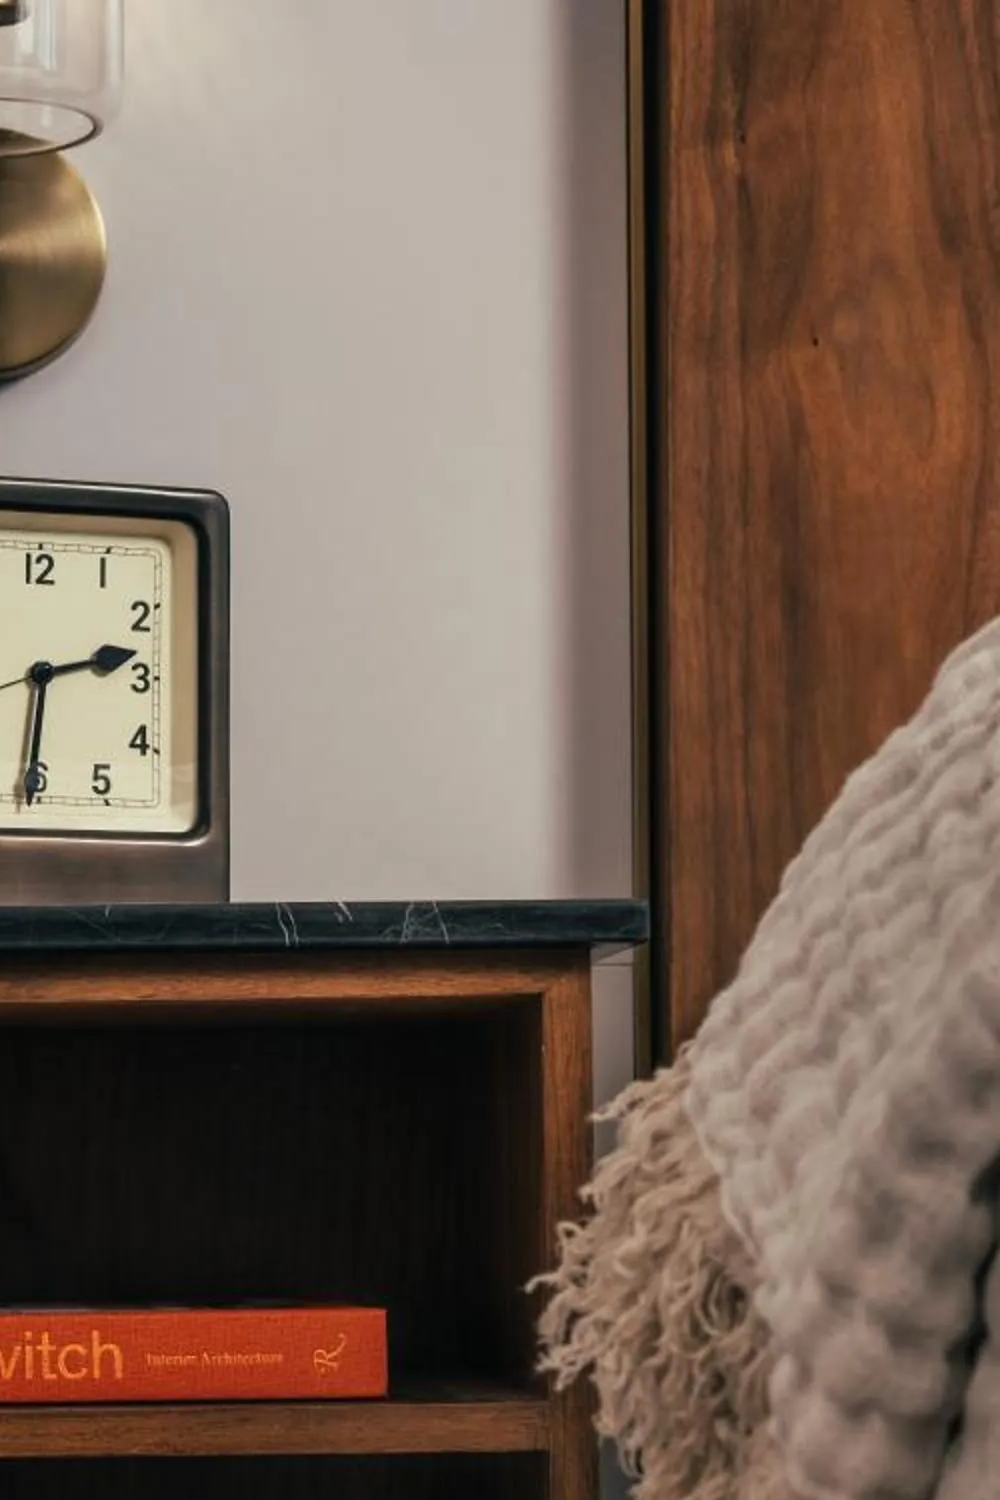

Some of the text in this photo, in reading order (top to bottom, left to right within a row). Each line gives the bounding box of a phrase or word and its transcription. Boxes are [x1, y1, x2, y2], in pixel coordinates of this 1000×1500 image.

[25, 553, 56, 586] 12
[99, 557, 107, 588] 1
[130, 601, 151, 632] 2
[130, 663, 150, 693] 3
[128, 724, 150, 756] 4
[91, 763, 111, 796] 5
